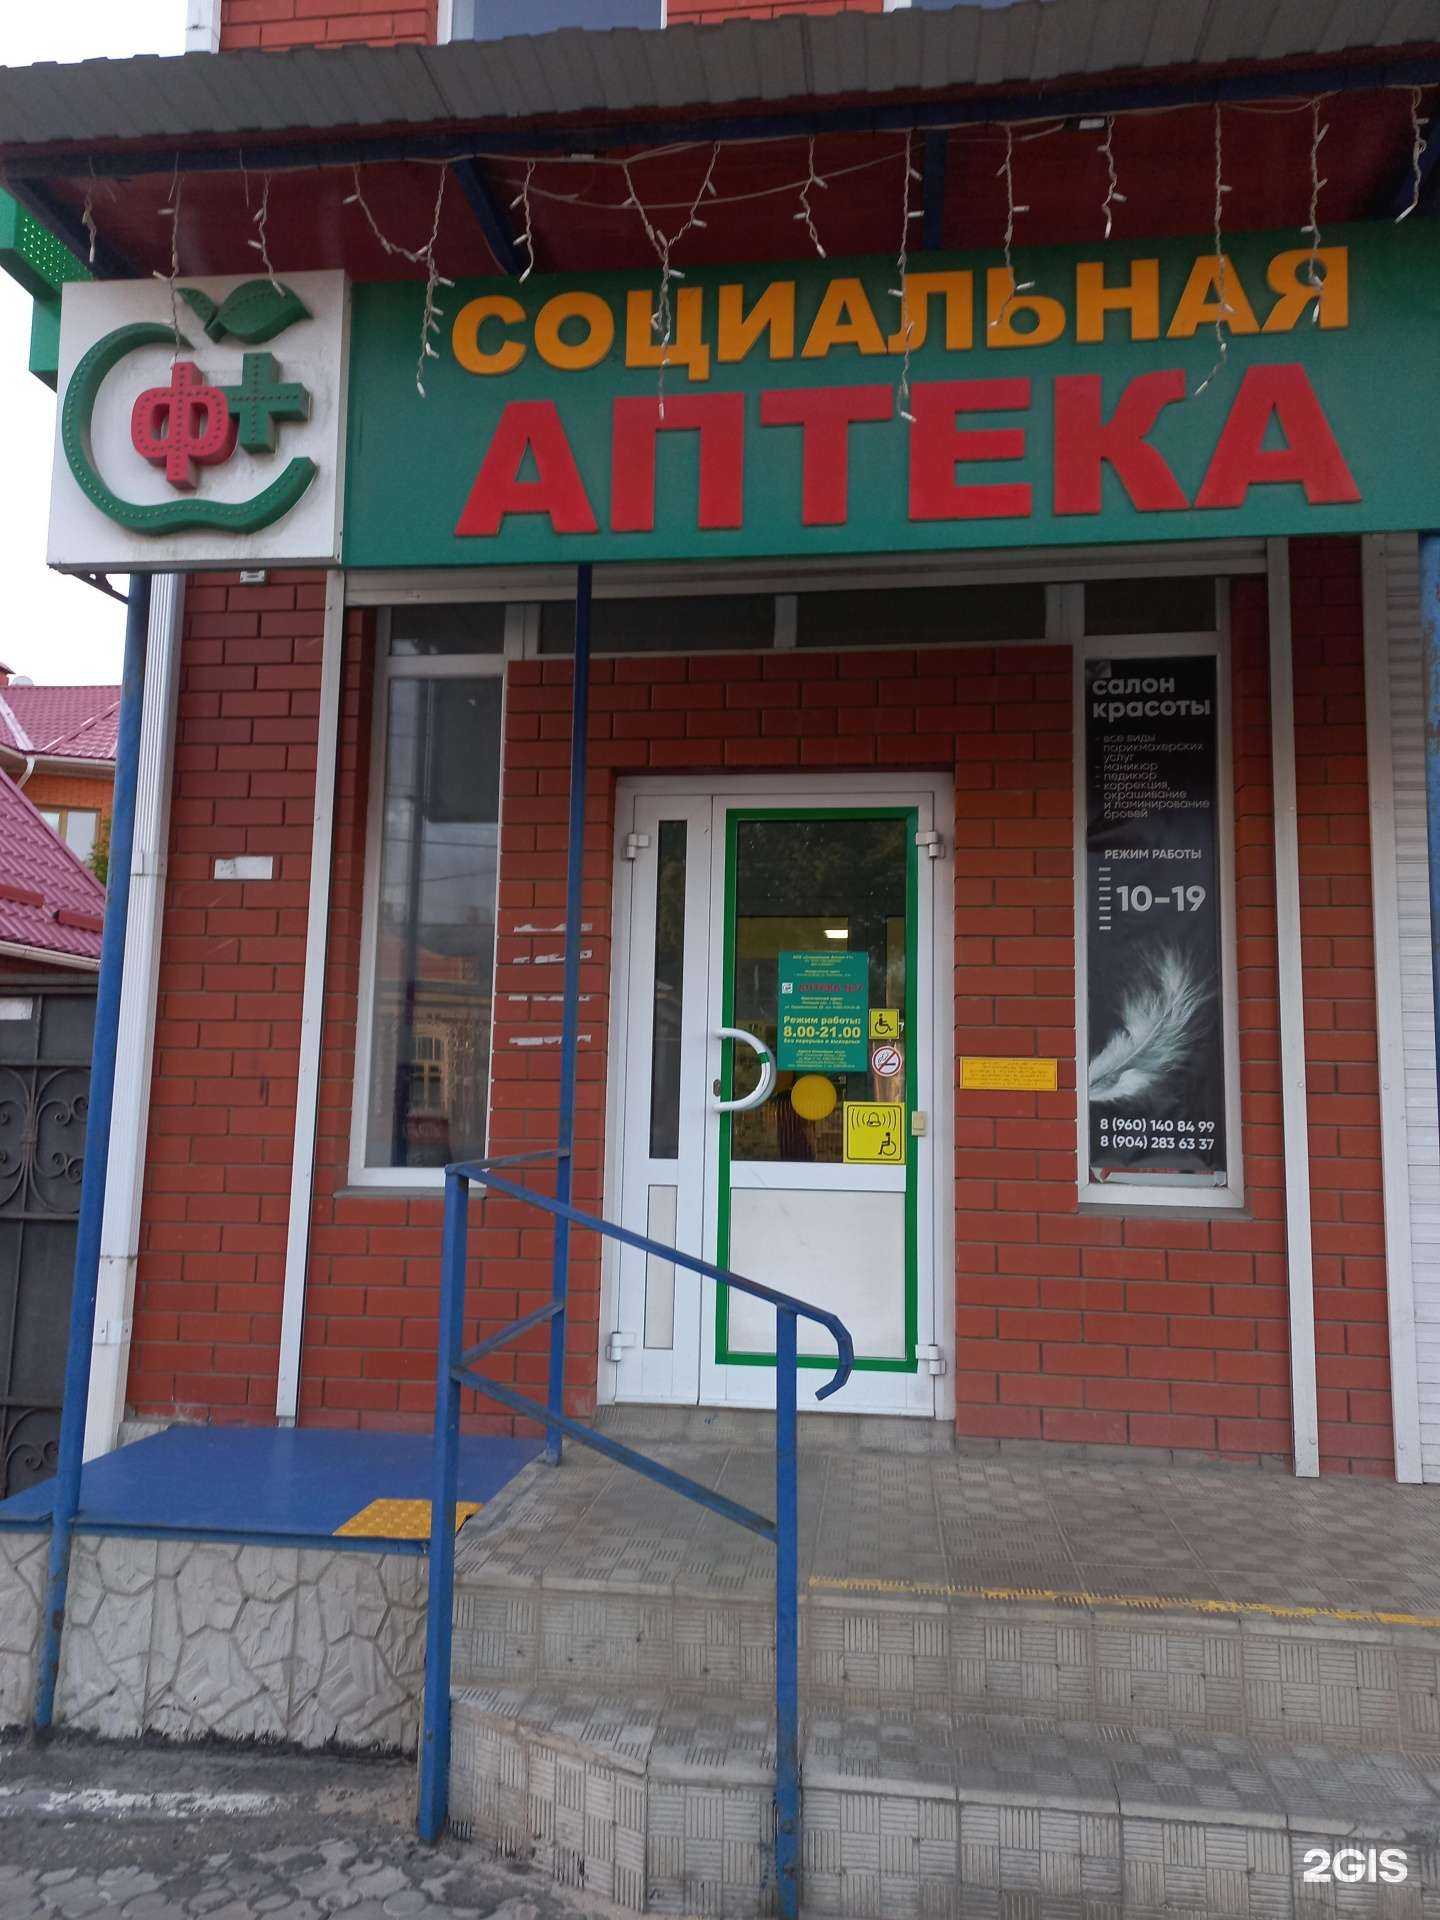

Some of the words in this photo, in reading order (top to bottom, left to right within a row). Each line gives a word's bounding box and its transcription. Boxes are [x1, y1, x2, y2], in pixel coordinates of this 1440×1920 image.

[452, 245, 1349, 381] СОЦИАЛЬНАЯ
[453, 362, 1363, 537] АПТЕКА
[1092, 677, 1175, 696] салон
[1092, 699, 1211, 723] красоты
[1127, 734, 1156, 744] виды
[1103, 743, 1205, 753] парикмахерских
[1103, 753, 1134, 763] услуг
[1103, 762, 1159, 772] маникюр
[1103, 772, 1158, 782] педикюр
[1103, 790, 1188, 801] окрашивание
[1104, 801, 1111, 809] и
[1114, 800, 1210, 810] ламинирование
[1103, 808, 1148, 820] бровей
[1104, 849, 1149, 860] РЕЖИМ
[1152, 849, 1202, 860] РАБОТЫ
[1116, 884, 1206, 912] 10-19
[783, 1015, 819, 1025] Режим
[783, 1025, 861, 1038] 8.00-21.00
[1099, 1118, 1109, 1130] 8
[1112, 1117, 1146, 1132] (960)
[1150, 1119, 1174, 1132] 140
[1177, 1120, 1195, 1133] 84
[1198, 1121, 1215, 1133] 99
[1100, 1135, 1109, 1147] 8
[1112, 1134, 1148, 1149] (904)
[1151, 1137, 1175, 1149] 283
[1178, 1138, 1196, 1150] 63
[1198, 1138, 1215, 1150] 37
